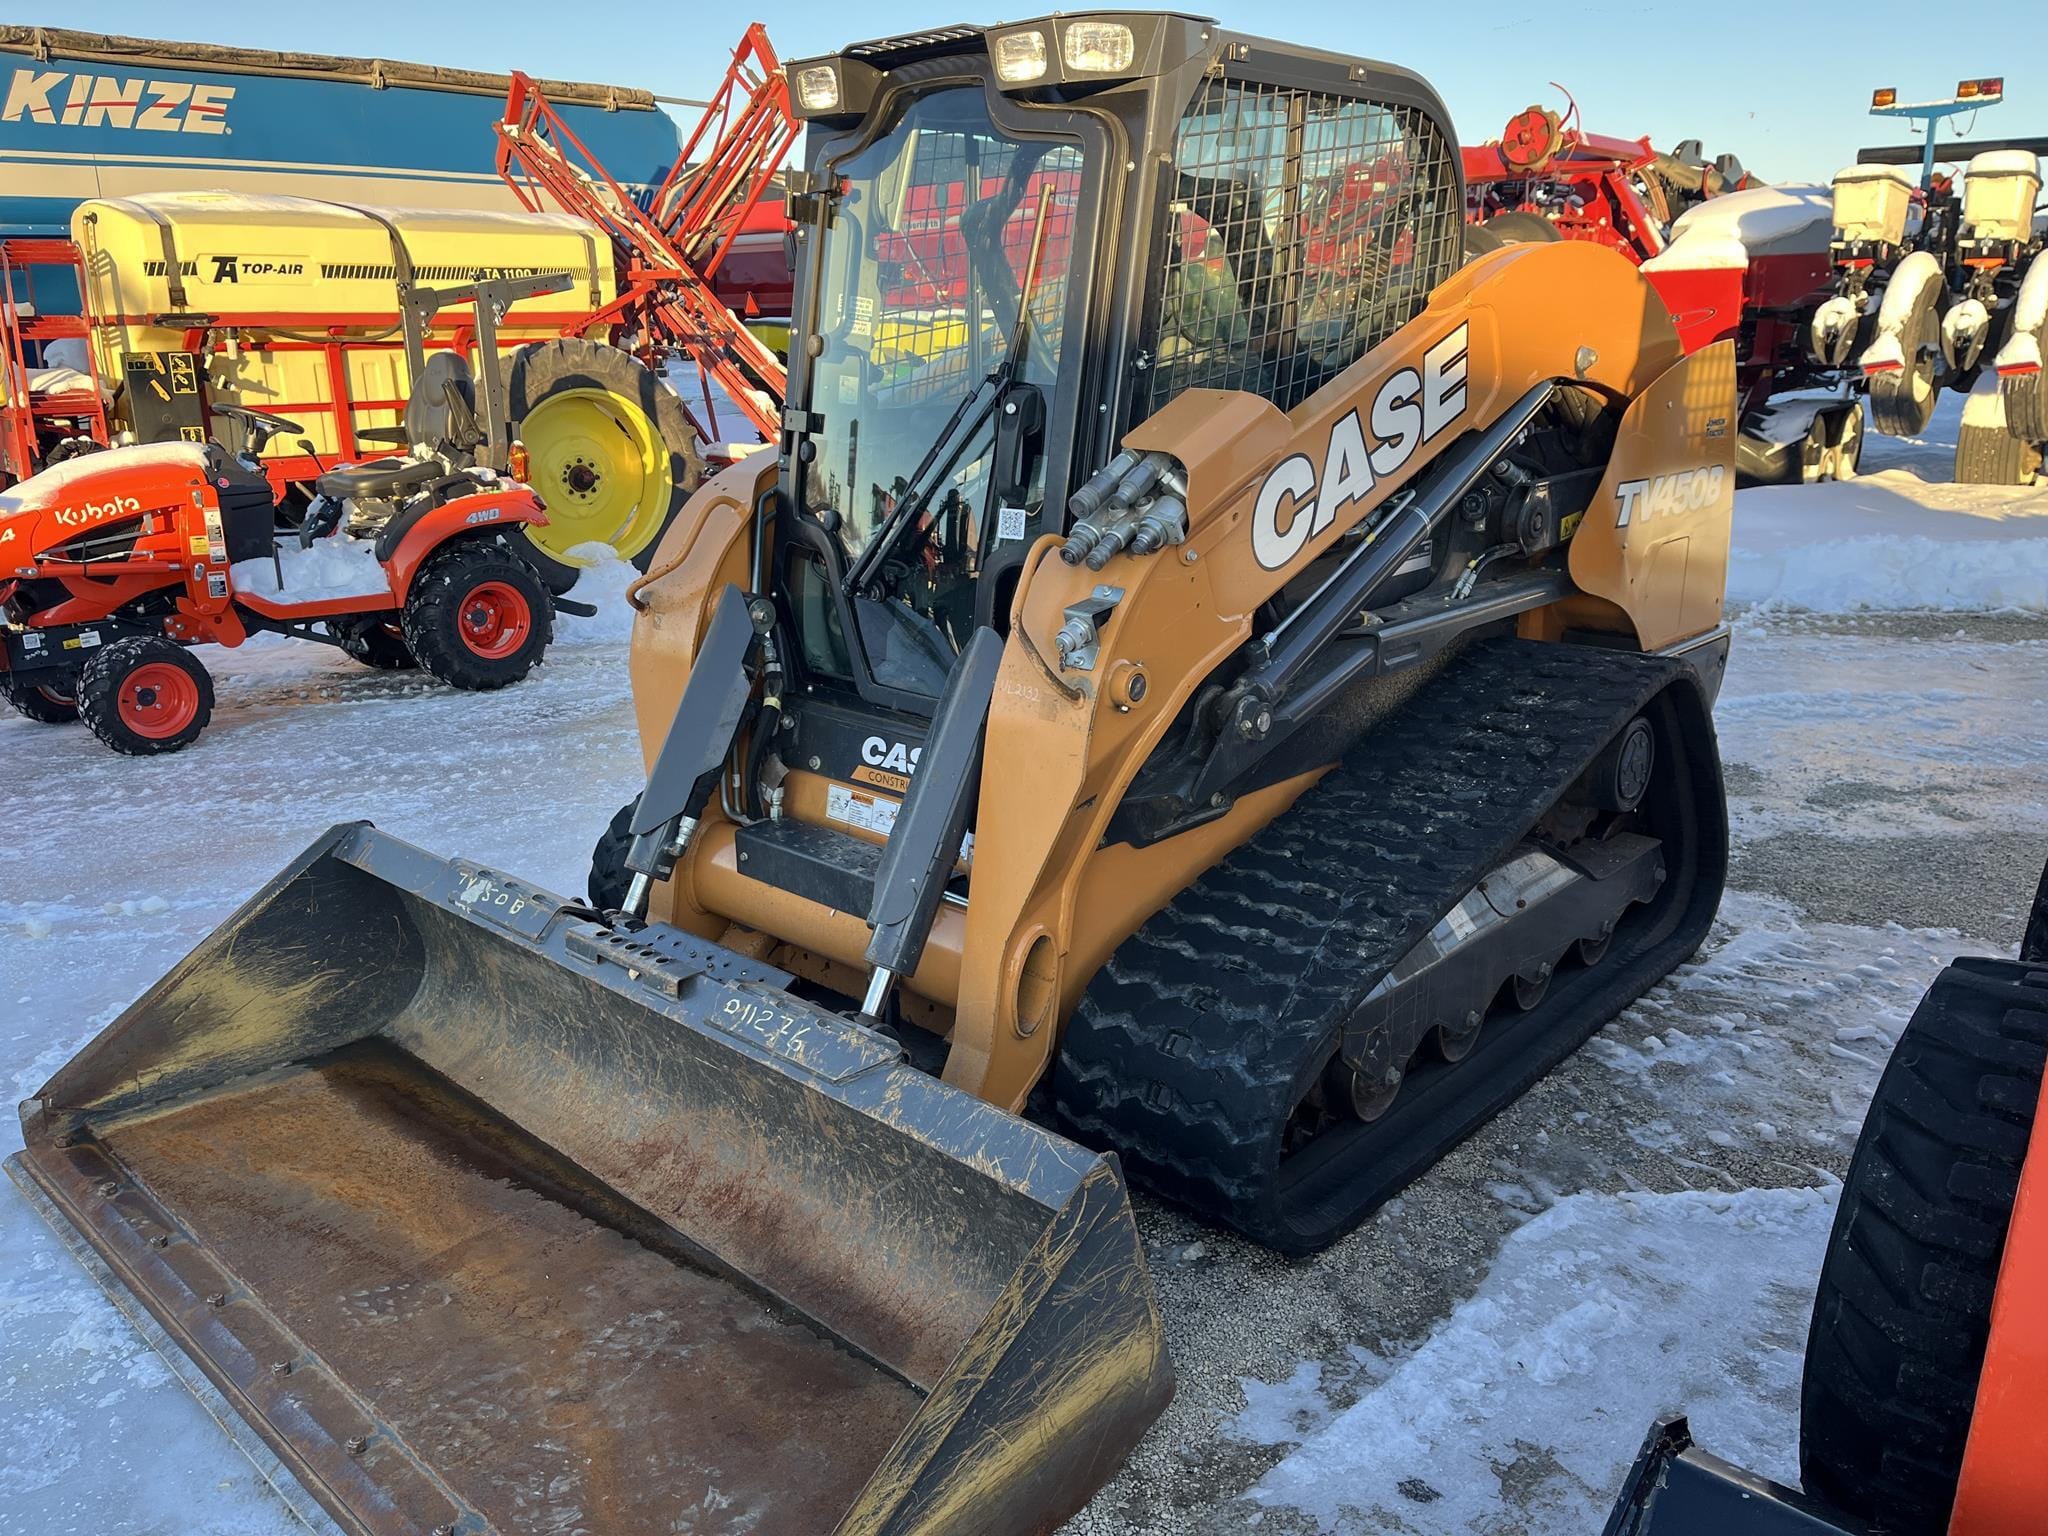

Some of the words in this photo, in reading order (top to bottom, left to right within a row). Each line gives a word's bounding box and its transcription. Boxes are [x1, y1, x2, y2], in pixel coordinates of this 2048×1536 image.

[1, 69, 236, 135] KINZE
[242, 263, 304, 275] TOP-AIR
[484, 268, 501, 280] TA
[503, 268, 532, 279] 1100
[1250, 318, 1470, 572] CASE
[54, 495, 140, 526] Kubota
[1615, 464, 1725, 529] TV450B
[465, 508, 500, 524] 4WD
[861, 736, 923, 775] CAS
[868, 771, 909, 790] CONSTR
